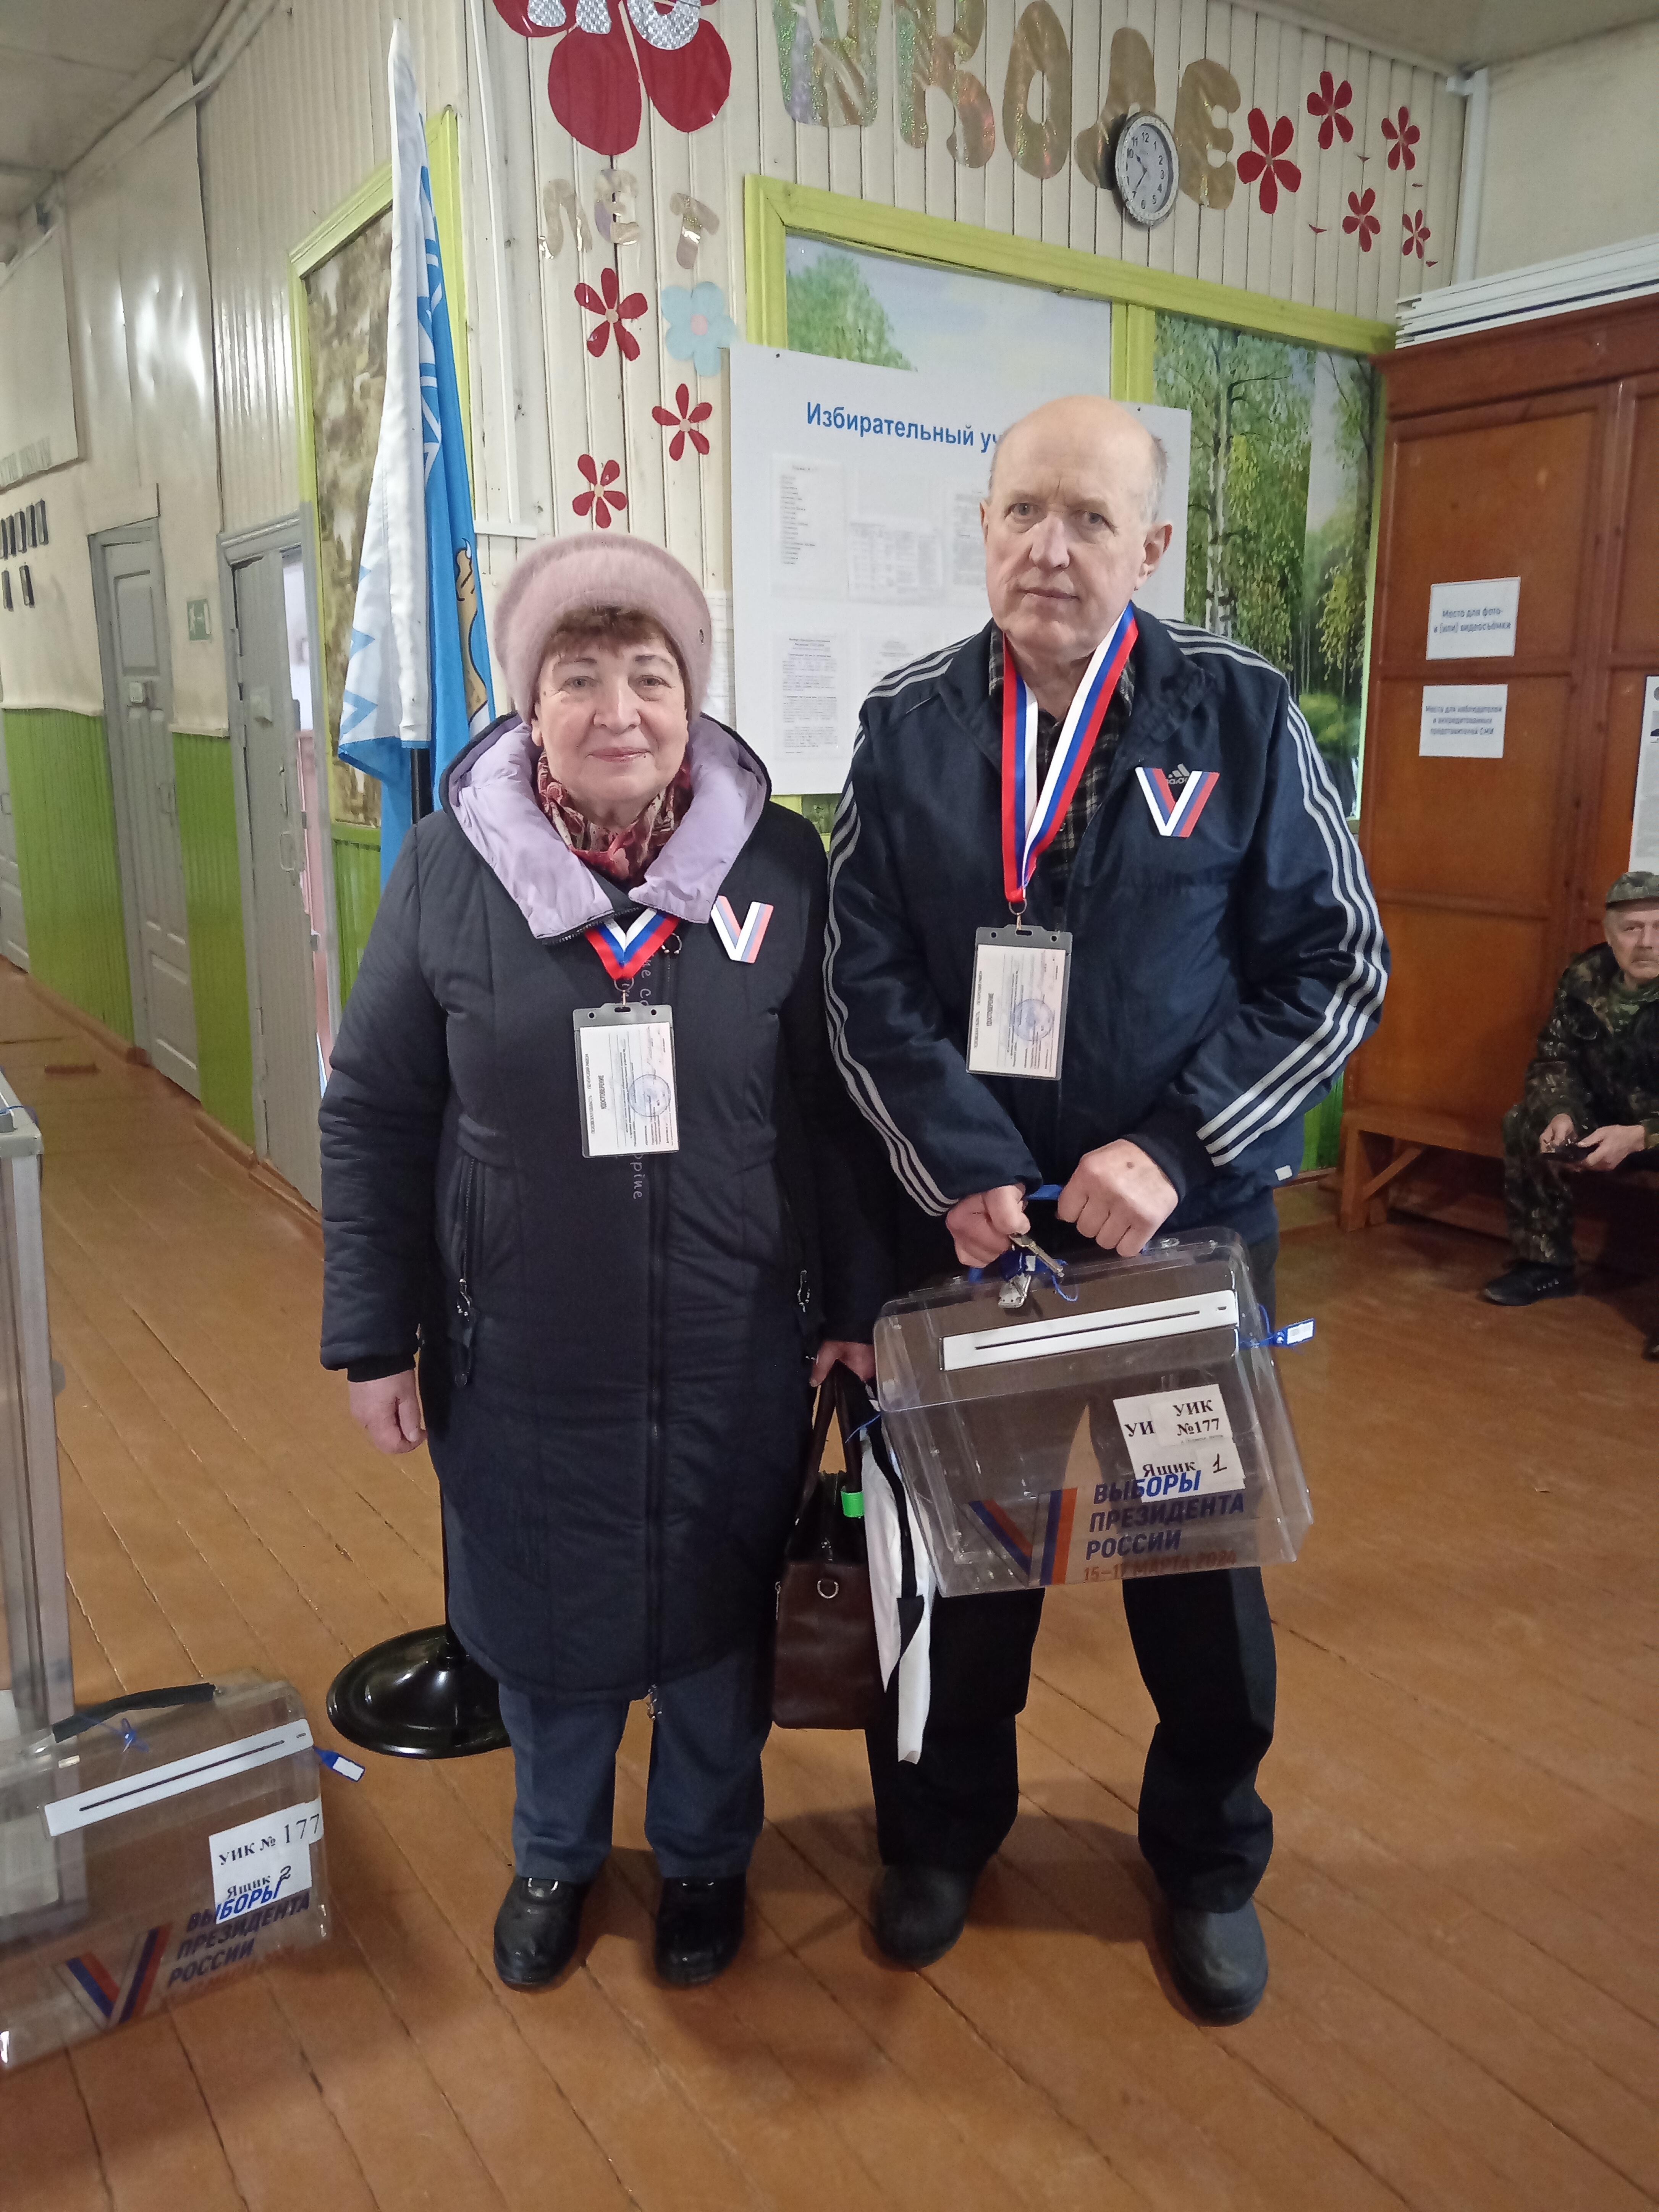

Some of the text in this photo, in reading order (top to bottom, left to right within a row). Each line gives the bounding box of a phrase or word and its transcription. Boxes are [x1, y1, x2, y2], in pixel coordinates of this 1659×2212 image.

[539, 169, 719, 270] ЛЕТ
[807, 402, 974, 446] Избирательный
[1172, 1399, 1214, 1416] УИК
[1124, 1420, 1156, 1437] УИ
[1176, 1418, 1220, 1436] №177
[1093, 1470, 1201, 1504] ВЫБОРЫ
[1142, 1462, 1197, 1477] Ящик
[1089, 1493, 1244, 1533] ПРЕЗИДЕНТА
[1086, 1529, 1181, 1560] РОССИИ
[218, 1842, 255, 1866] УИК
[284, 1813, 320, 1844] 177
[226, 1875, 271, 1898] Ящик
[187, 1878, 282, 1933] ВЫБОРЫ
[176, 1891, 310, 1960] ПРЕЗИДЕНТА
[168, 1937, 255, 1989] РОССИИ
